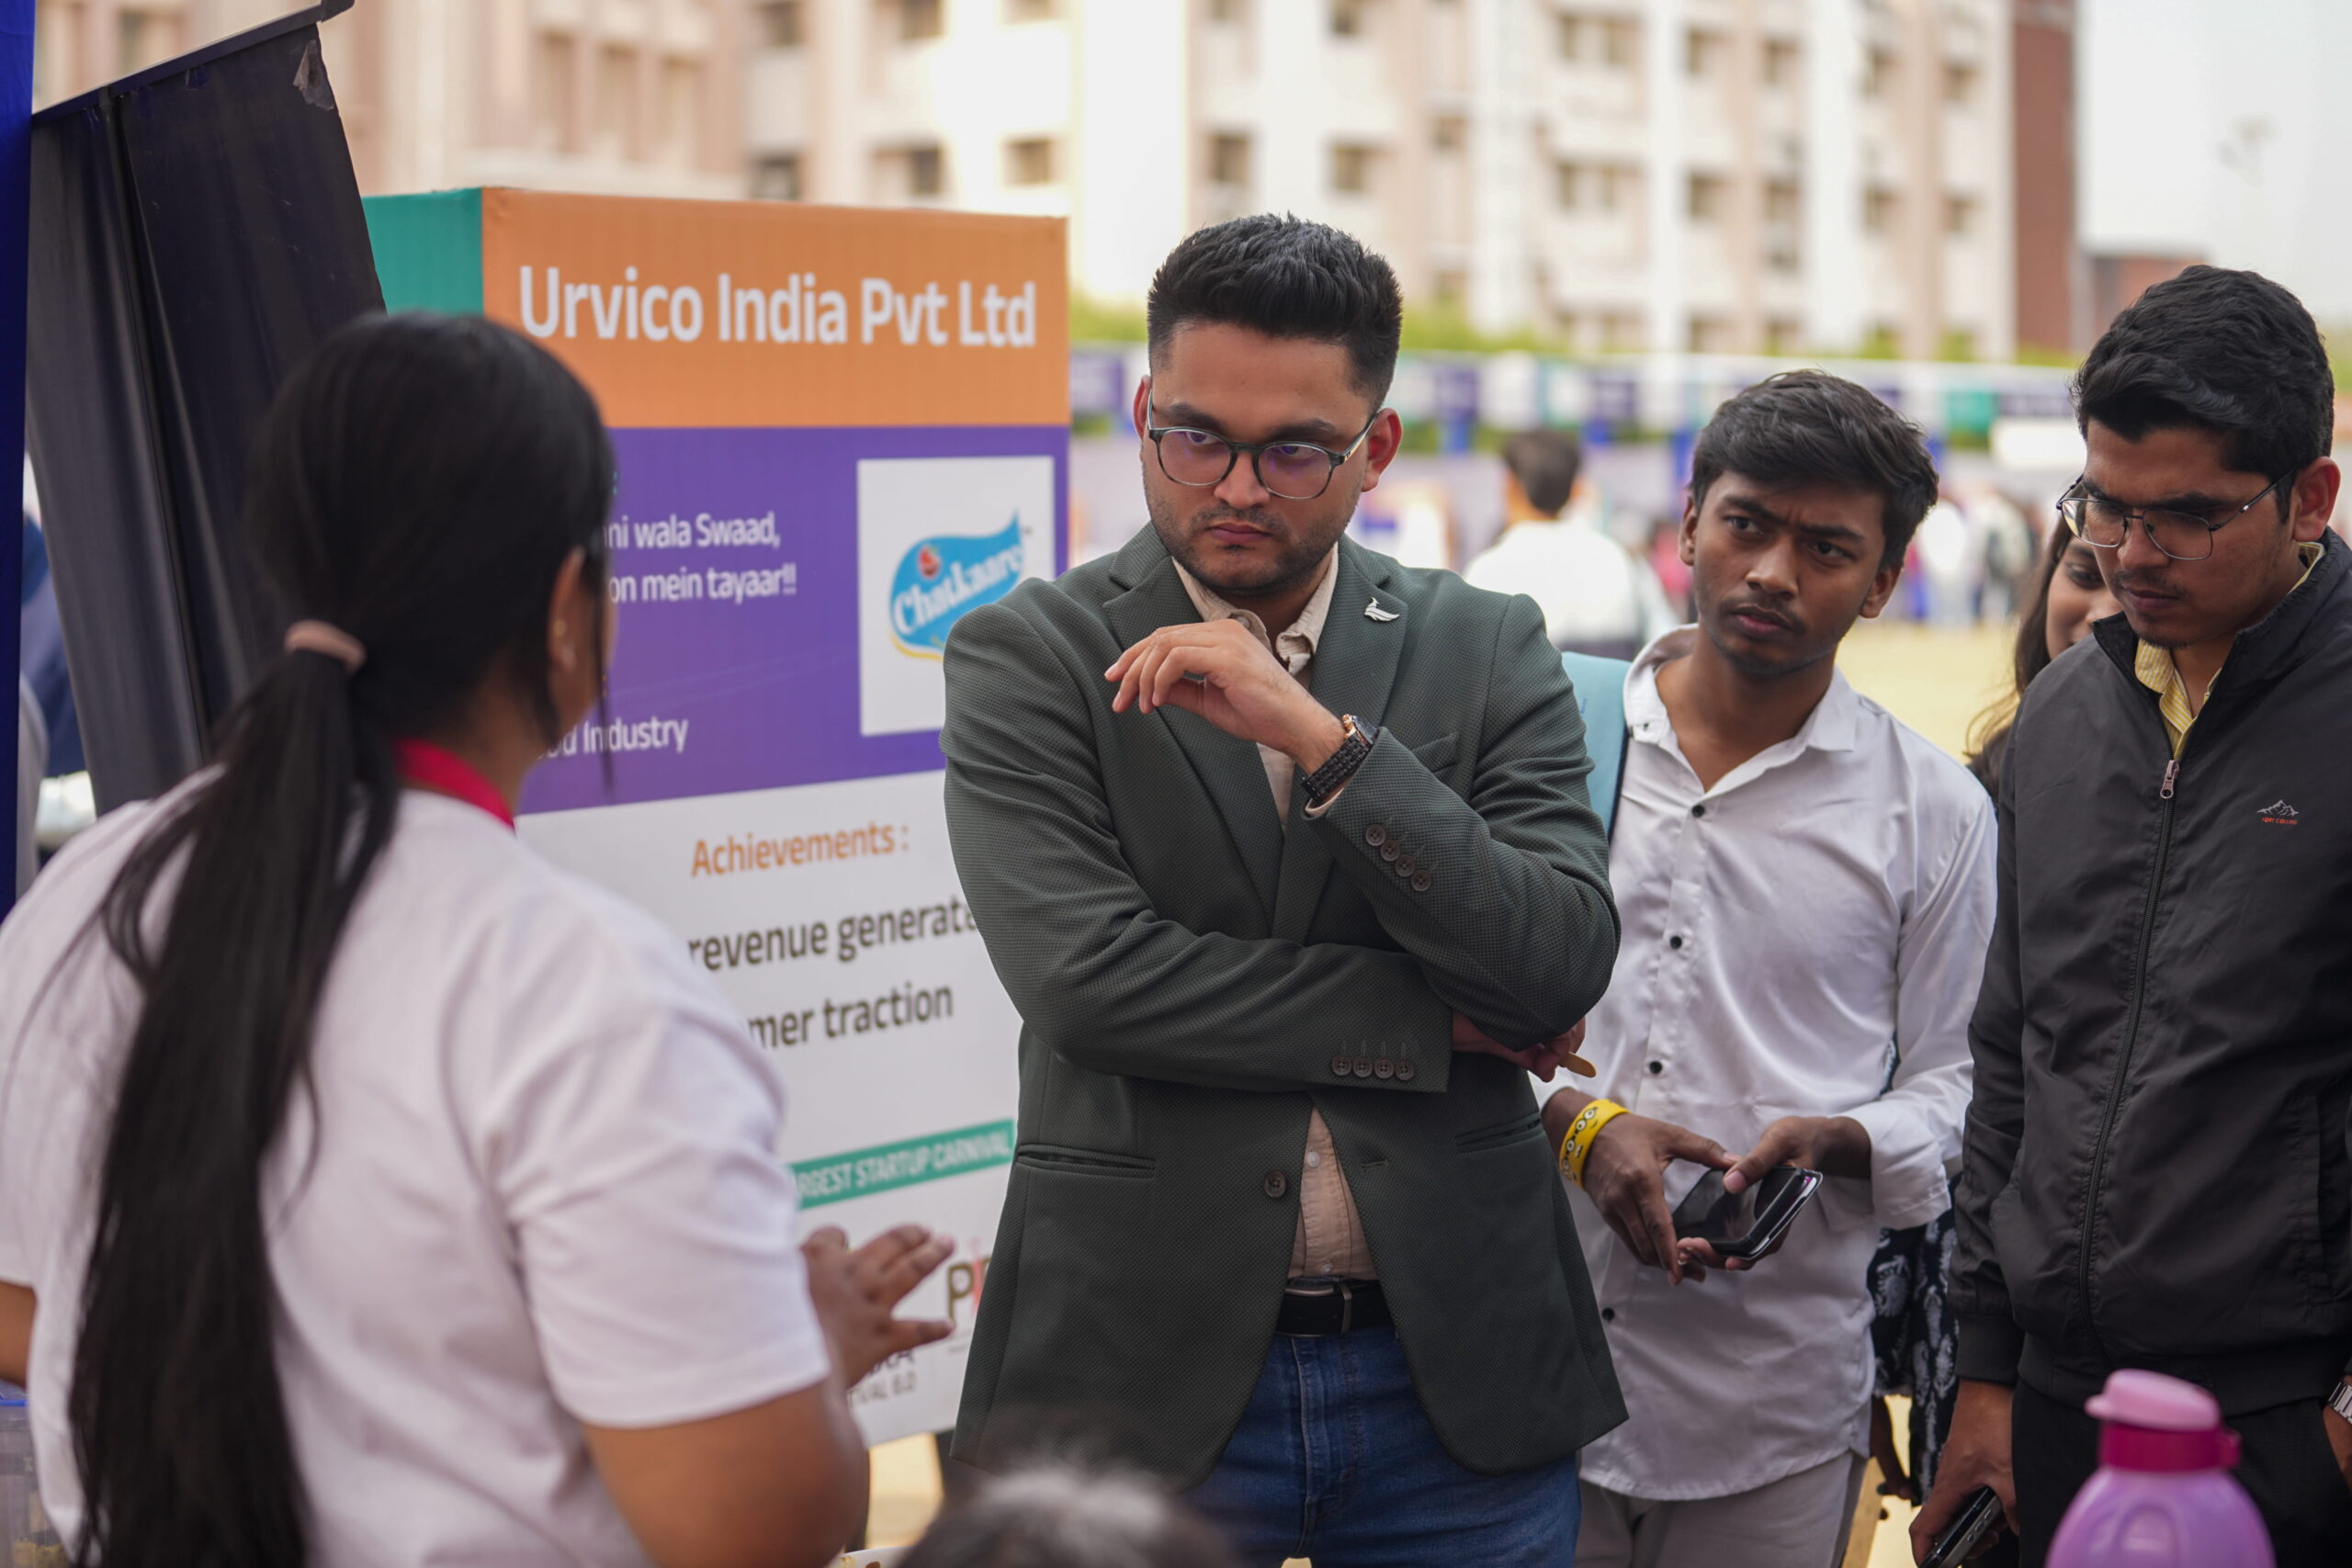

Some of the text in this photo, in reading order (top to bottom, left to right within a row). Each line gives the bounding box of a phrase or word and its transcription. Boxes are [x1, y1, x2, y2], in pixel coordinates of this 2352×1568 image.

[519, 265, 1035, 346] Urvico India Pvt Ltd
[633, 513, 692, 548] wala
[695, 511, 780, 548] Swaad,
[642, 566, 703, 601] mein
[582, 716, 689, 753] Industry
[688, 921, 828, 971] revenue
[822, 982, 952, 1038] traction
